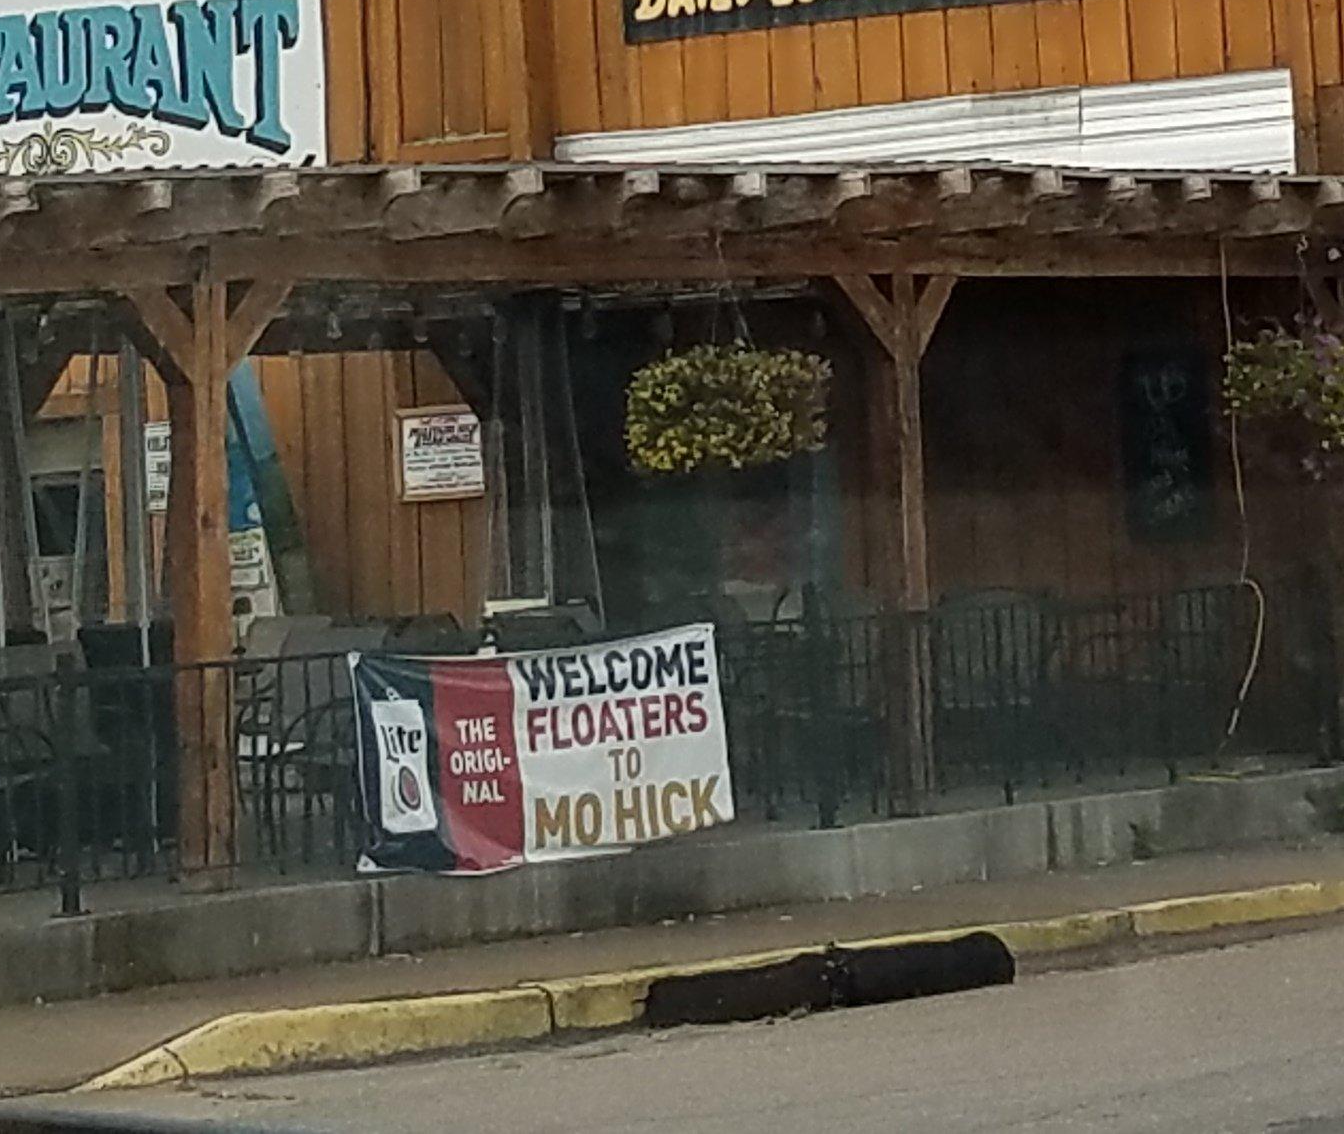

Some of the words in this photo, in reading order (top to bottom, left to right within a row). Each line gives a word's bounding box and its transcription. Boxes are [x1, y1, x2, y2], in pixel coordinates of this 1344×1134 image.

[516, 640, 709, 700] WELCOME
[455, 717, 496, 744] THE
[526, 691, 708, 753] FLOATERS
[380, 725, 421, 763] Lite
[450, 747, 511, 775] ORIGI-
[608, 746, 641, 782] TO
[463, 779, 504, 804] NAL
[534, 792, 602, 850] MO
[614, 774, 723, 843] HICK
